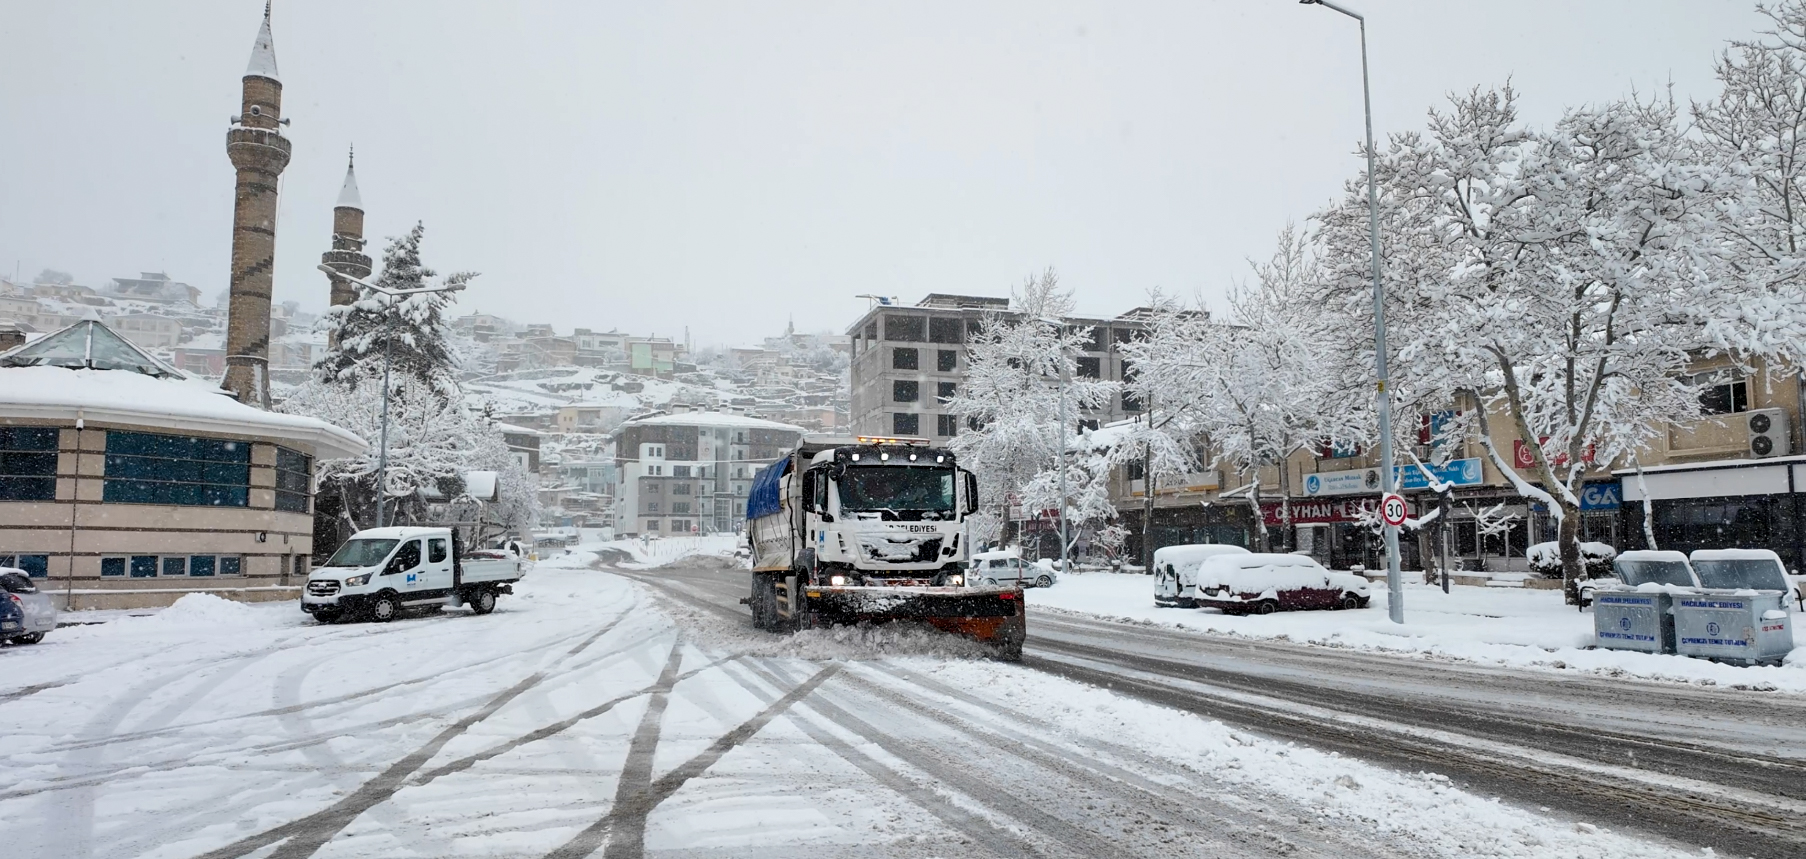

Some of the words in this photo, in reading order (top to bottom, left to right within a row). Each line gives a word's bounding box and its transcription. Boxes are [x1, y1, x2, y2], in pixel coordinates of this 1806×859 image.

[1275, 503, 1332, 520] CYHAN
[1387, 503, 1403, 519] 30
[1681, 600, 1706, 608] HACILAR
